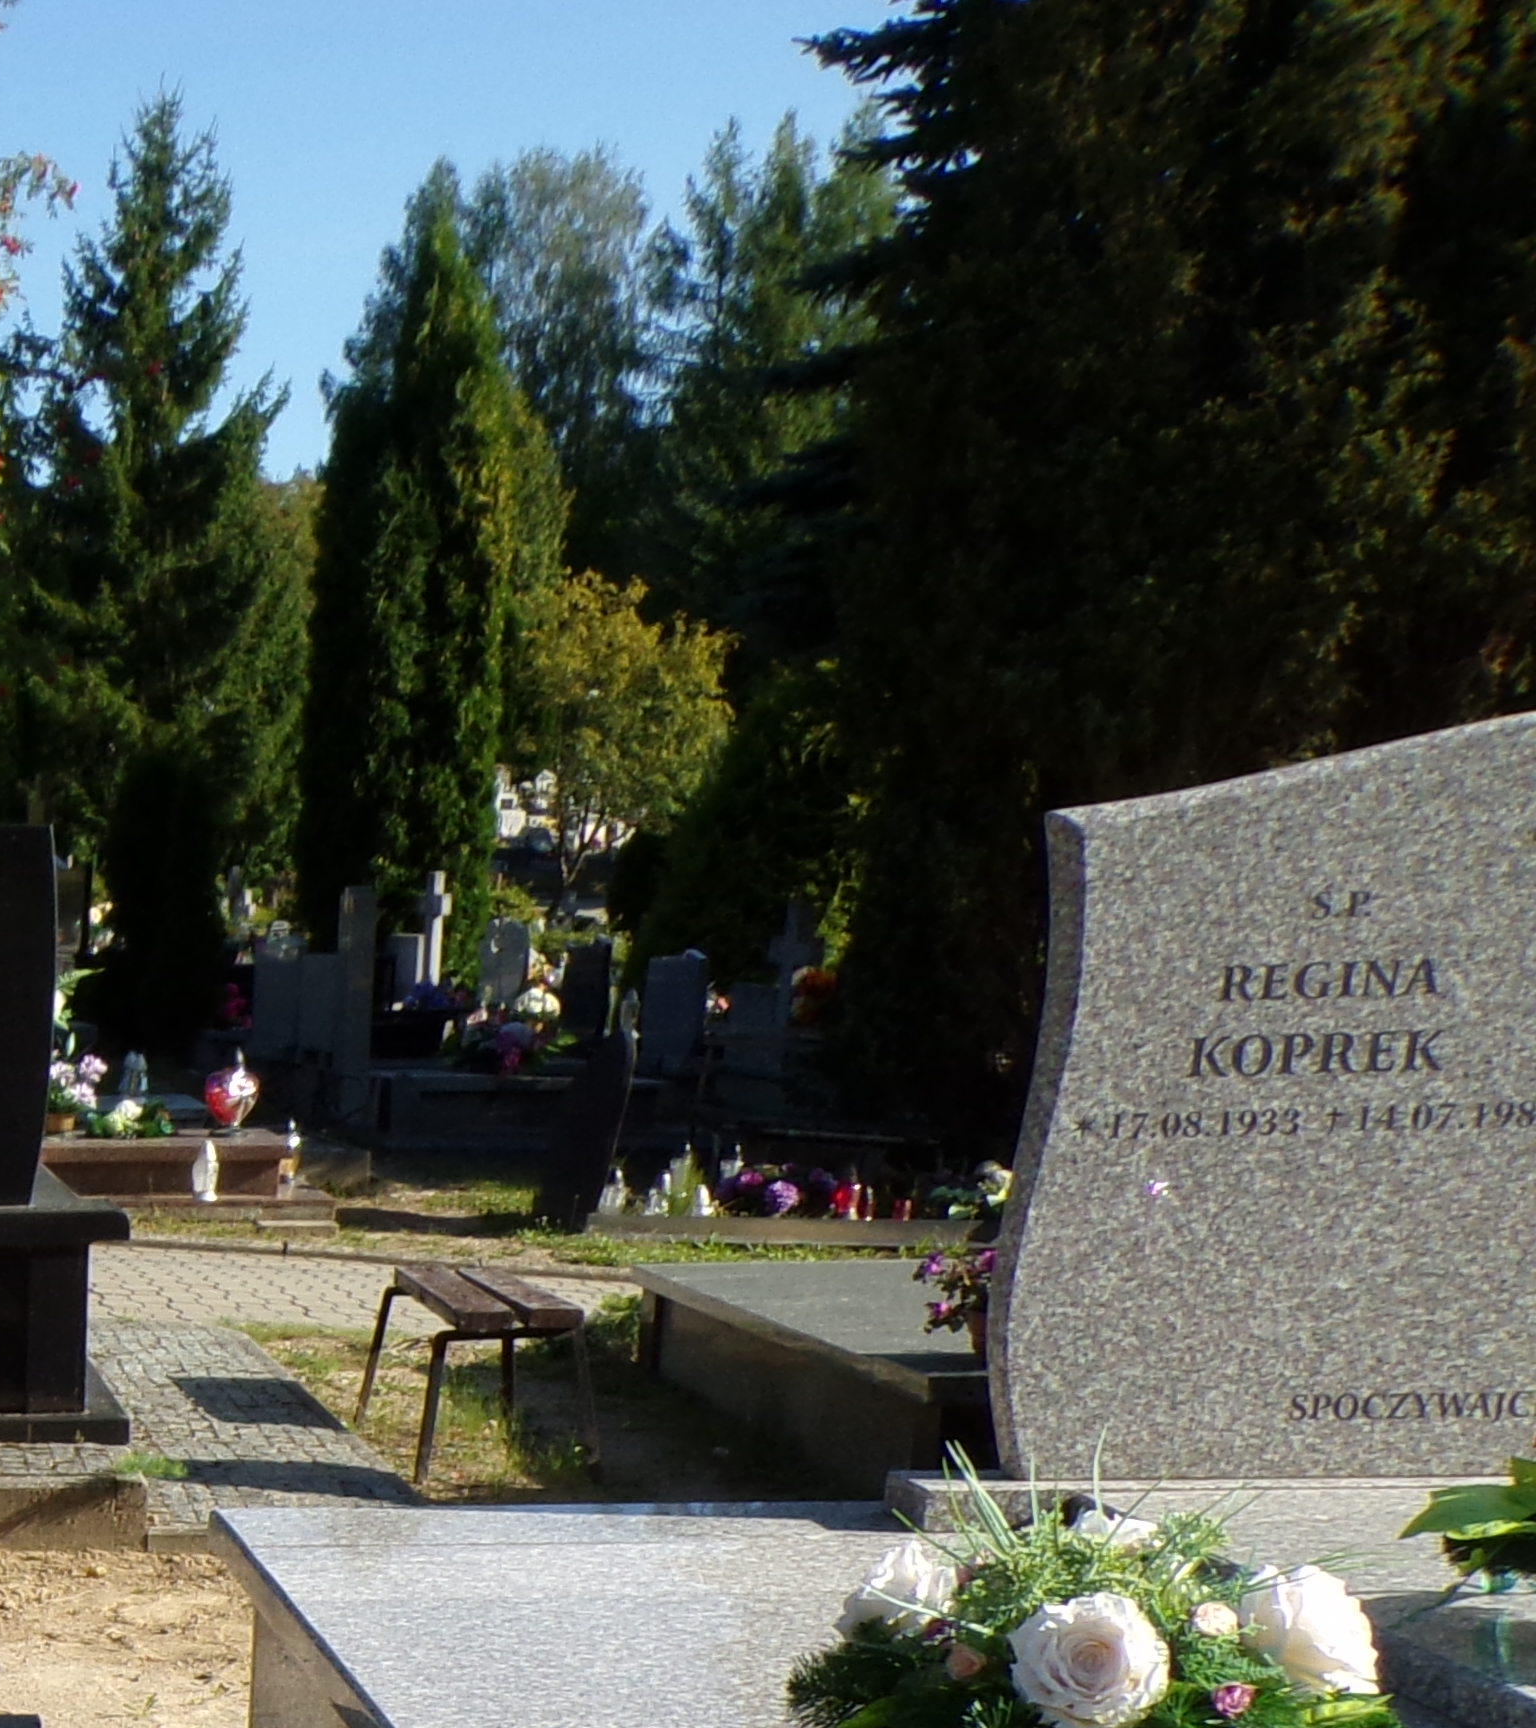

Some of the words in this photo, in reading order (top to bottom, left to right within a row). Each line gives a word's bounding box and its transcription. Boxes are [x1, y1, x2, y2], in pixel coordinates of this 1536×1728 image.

[1216, 957, 1442, 1003] REGINA
[1186, 1028, 1445, 1079] KOPREK
[1107, 1108, 1302, 1140] 17.08.1933
[1289, 1390, 1536, 1423] SPOCZYWAJC
